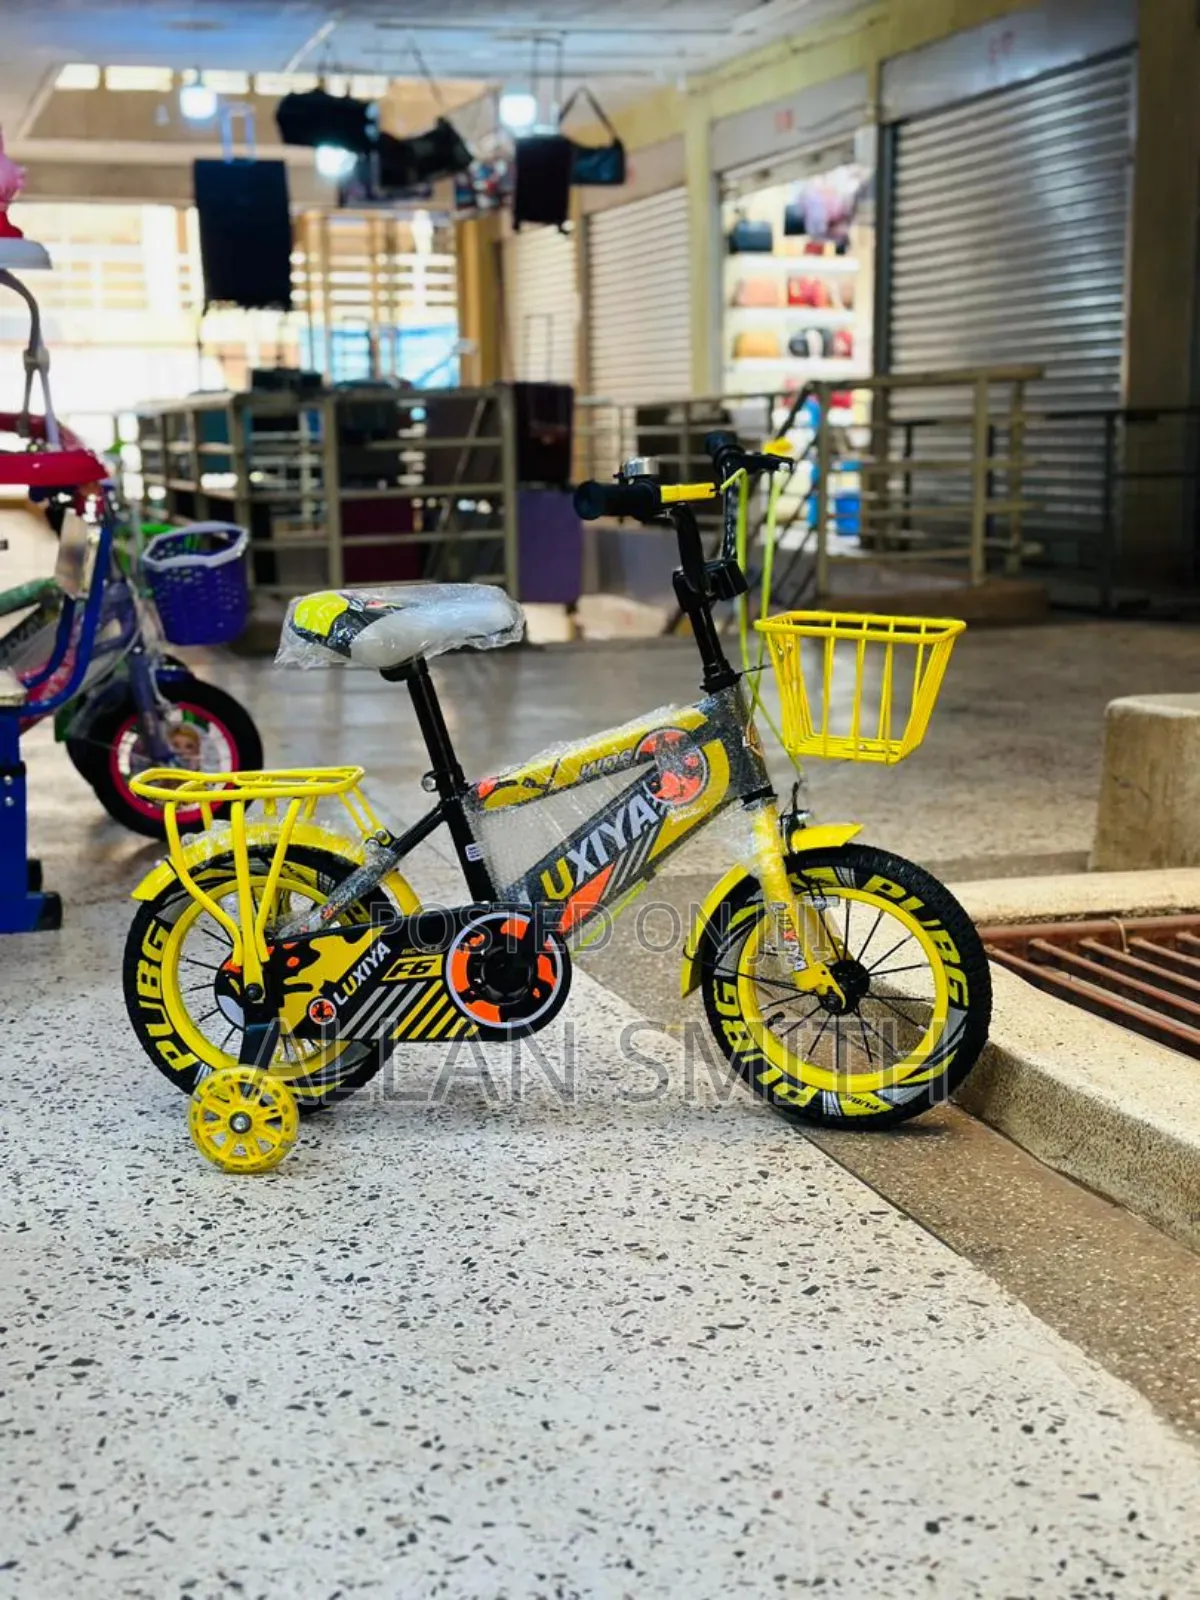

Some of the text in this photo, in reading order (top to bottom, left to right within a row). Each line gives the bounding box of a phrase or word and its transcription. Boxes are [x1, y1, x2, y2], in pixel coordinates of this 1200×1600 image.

[136, 920, 200, 1071] PUBG
[333, 941, 391, 1005] LUXIYA
[387, 960, 437, 978] F6
[862, 874, 969, 1007] PUBG
[713, 979, 819, 1107] PUBG
